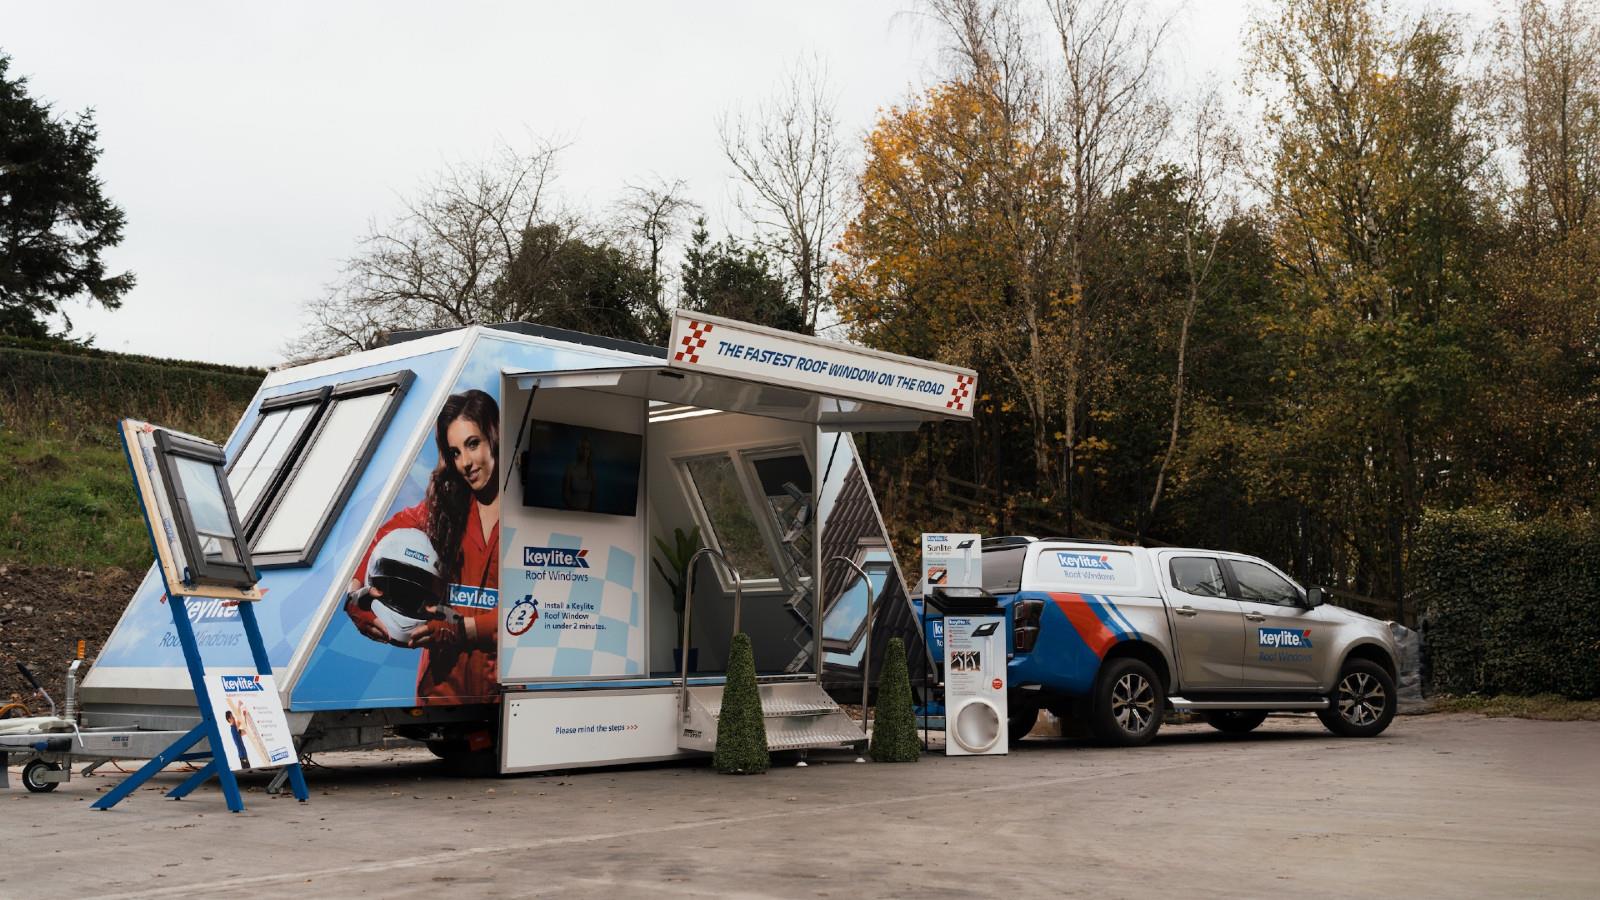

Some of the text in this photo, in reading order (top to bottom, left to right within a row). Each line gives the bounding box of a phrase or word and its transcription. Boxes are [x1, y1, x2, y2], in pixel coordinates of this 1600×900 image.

[718, 341, 945, 396] THE FASTEST ROOF WINDOW ON THE ROAD
[927, 544, 952, 552] Sunlite
[525, 548, 574, 567] keylite
[1058, 554, 1100, 568] keylite
[525, 570, 589, 582] Roof Windows
[1063, 570, 1116, 581] Roof Windows
[449, 587, 496, 606] keylite
[571, 602, 595, 611] Keylite
[517, 610, 527, 621] 2
[544, 612, 590, 620] Roof Window
[579, 623, 607, 631] minutes.
[159, 631, 183, 648] Roo
[1259, 629, 1301, 648] keylite
[222, 676, 255, 692] keylite
[555, 724, 625, 735] Please mind the steps
